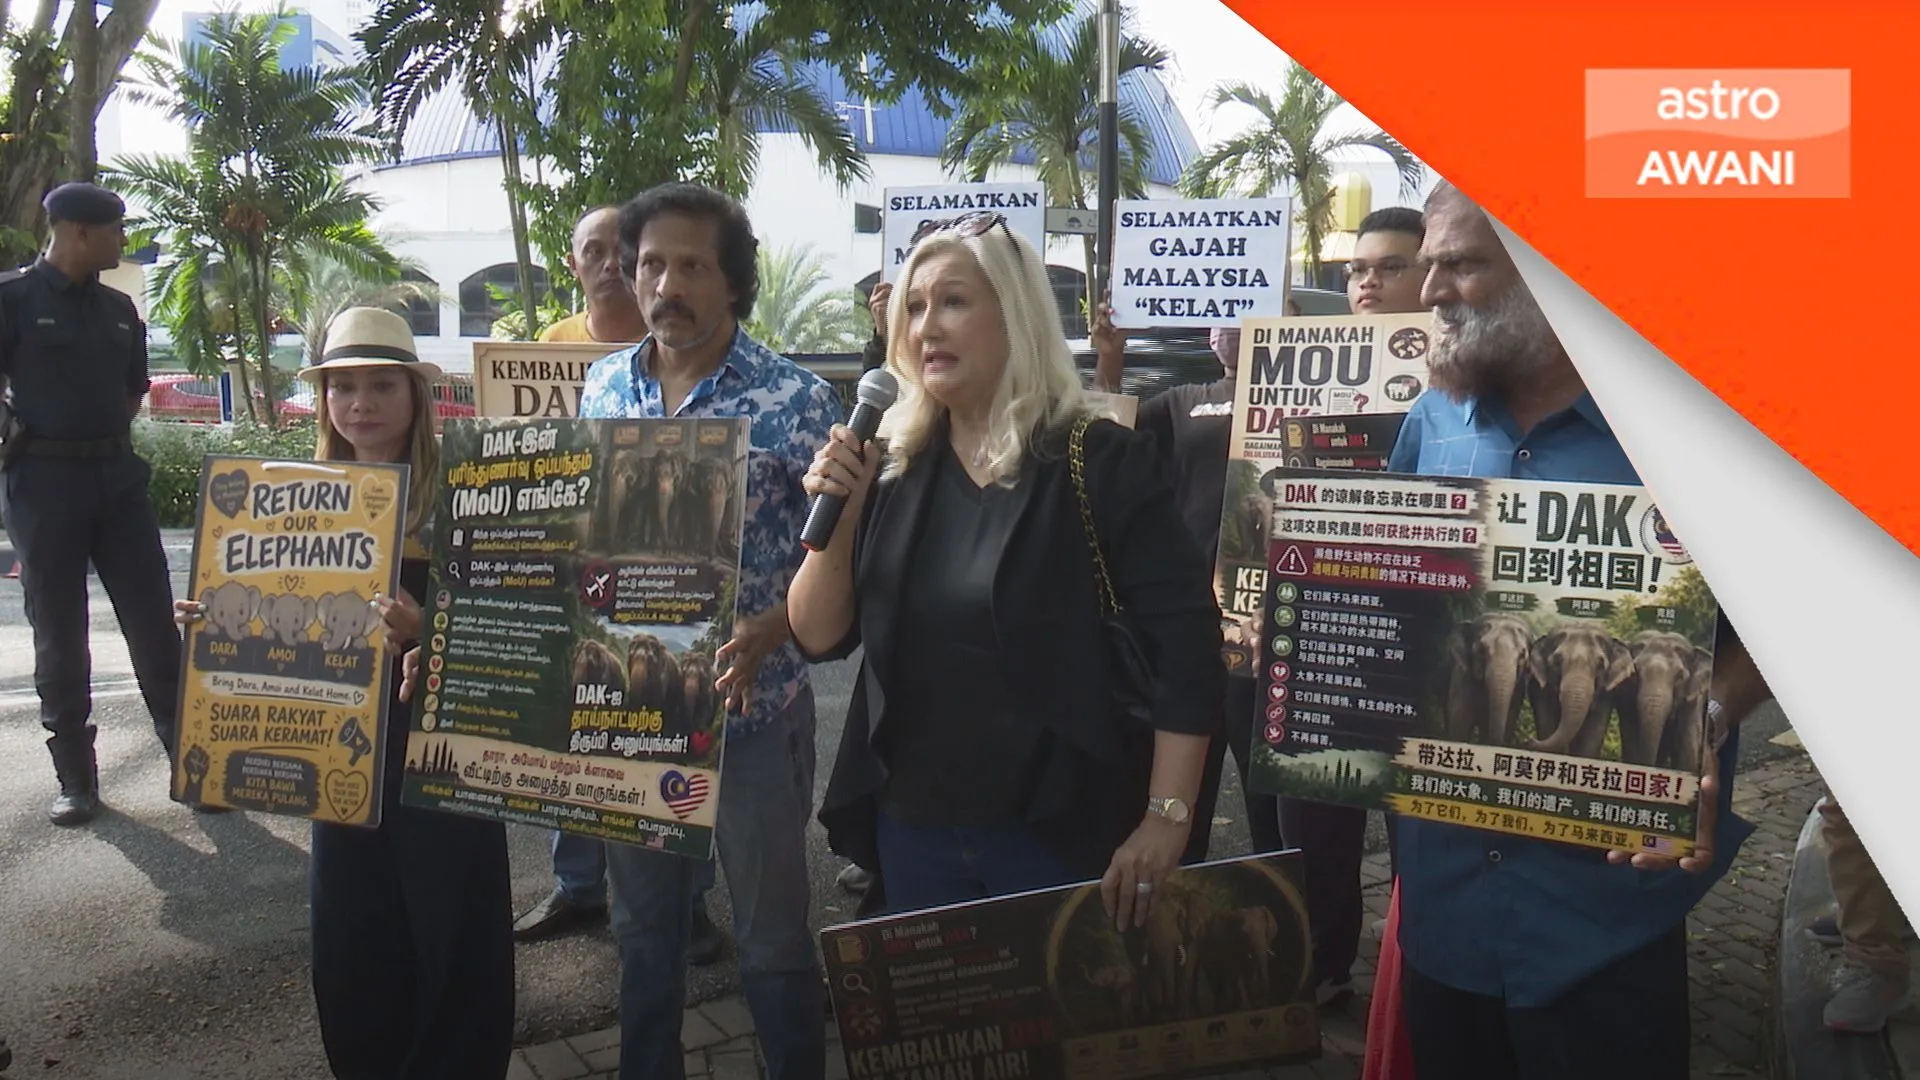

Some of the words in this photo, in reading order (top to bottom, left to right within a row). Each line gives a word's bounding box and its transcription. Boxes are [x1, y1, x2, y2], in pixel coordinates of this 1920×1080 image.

[891, 191, 1038, 212] SELAMATKAN
[1120, 210, 1282, 228] SELAMATKAN
[1149, 237, 1247, 257] GAJAH
[1123, 268, 1269, 287] MALAYSIA
[1135, 298, 1254, 318] “KELAT”
[1254, 327, 1271, 344] DI
[1278, 326, 1374, 344] MANAKAH
[1250, 345, 1374, 386] MOU
[1249, 387, 1322, 406] UNTUK
[482, 423, 559, 458] DAK-இன்
[534, 448, 592, 480] ஒப்பந்தம்
[253, 482, 351, 519] RETURN
[452, 486, 512, 520] (MoU)
[517, 476, 591, 512] எங்கே?
[1285, 484, 1317, 503] DAK
[283, 515, 317, 531] OUR
[1497, 493, 1527, 524] 让
[1536, 491, 1636, 547] DAK
[226, 532, 375, 573] ELEPHANTS
[1492, 545, 1662, 594] 回到祖国！
[210, 641, 238, 656] DARA
[268, 647, 296, 662] AMOI
[325, 654, 359, 670] KELAT
[212, 676, 235, 691] Bring
[237, 679, 259, 693] Dara,
[261, 682, 281, 694] Amoi
[283, 684, 300, 695] and
[303, 685, 323, 697] Kelat
[210, 703, 262, 723] SUARA
[267, 706, 327, 727] RAKYAT
[210, 724, 259, 742] SUARA
[264, 727, 333, 746] KERAMAT!
[517, 774, 571, 796] அழைத்து
[850, 1024, 1003, 1078] KEMBALIKAN
